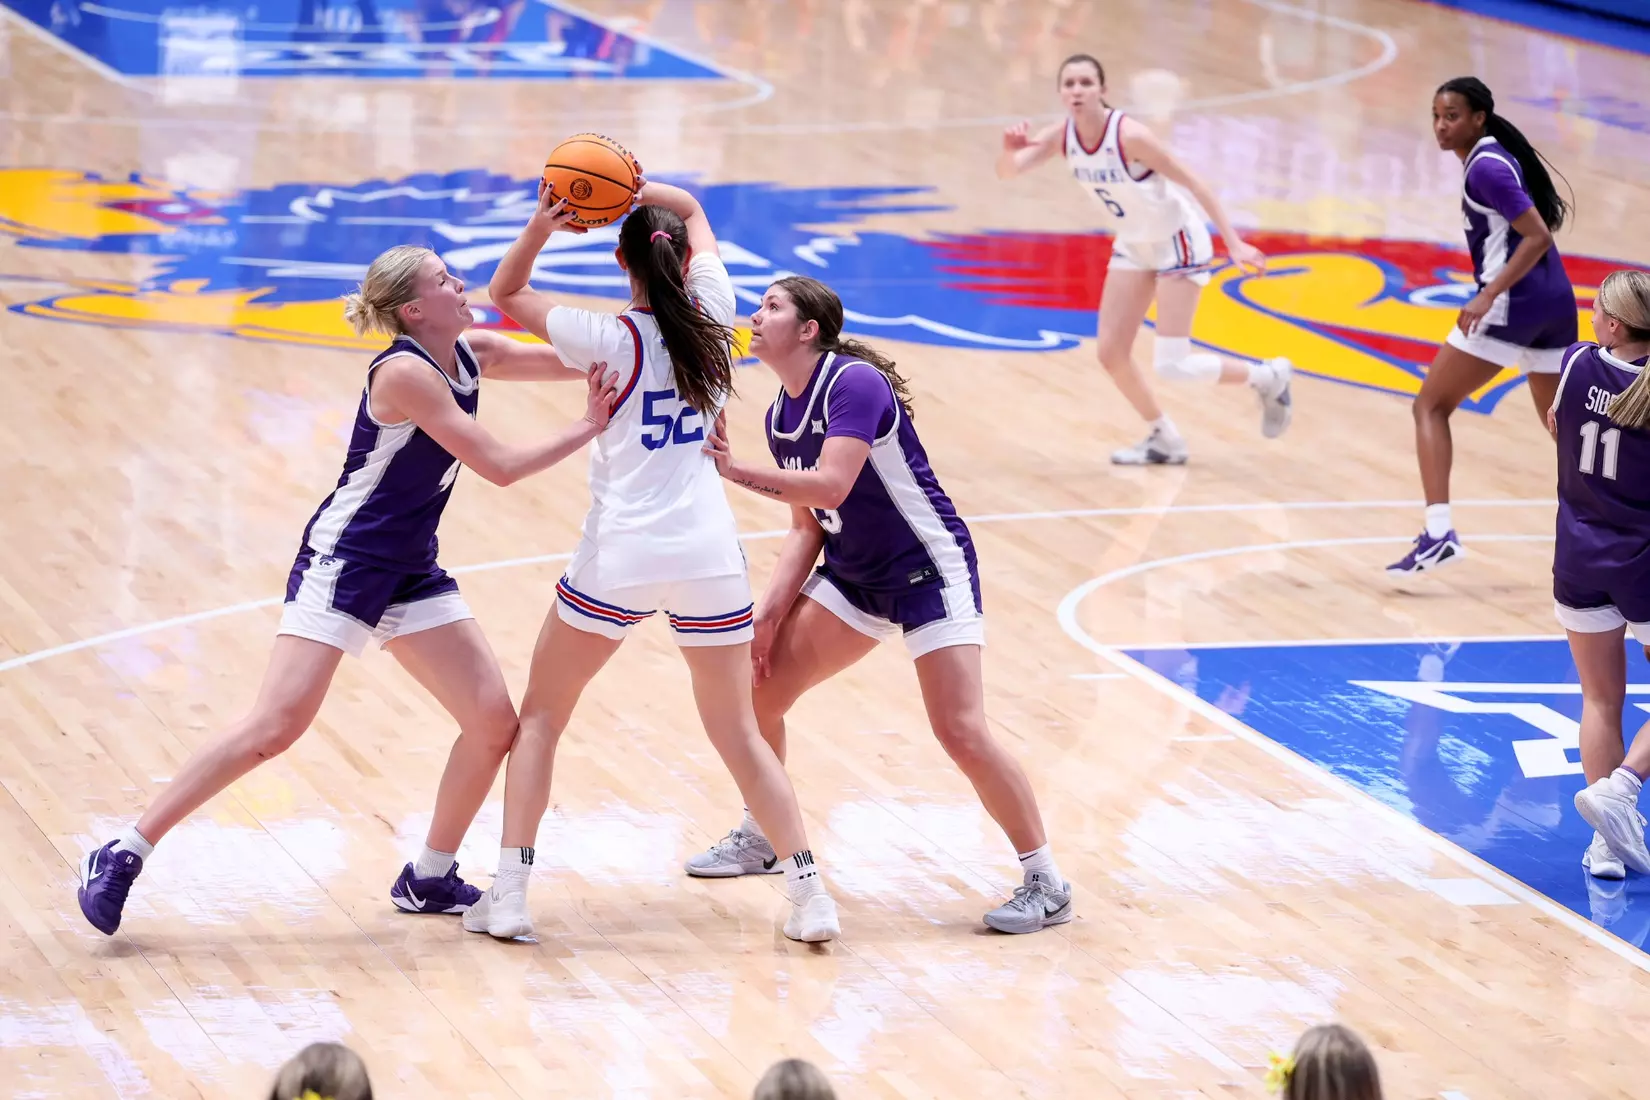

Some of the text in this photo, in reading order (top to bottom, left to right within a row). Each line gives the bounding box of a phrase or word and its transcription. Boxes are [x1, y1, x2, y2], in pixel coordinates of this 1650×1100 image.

[1094, 187, 1125, 217] 6
[641, 388, 704, 451] 52
[1579, 420, 1621, 480] 11
